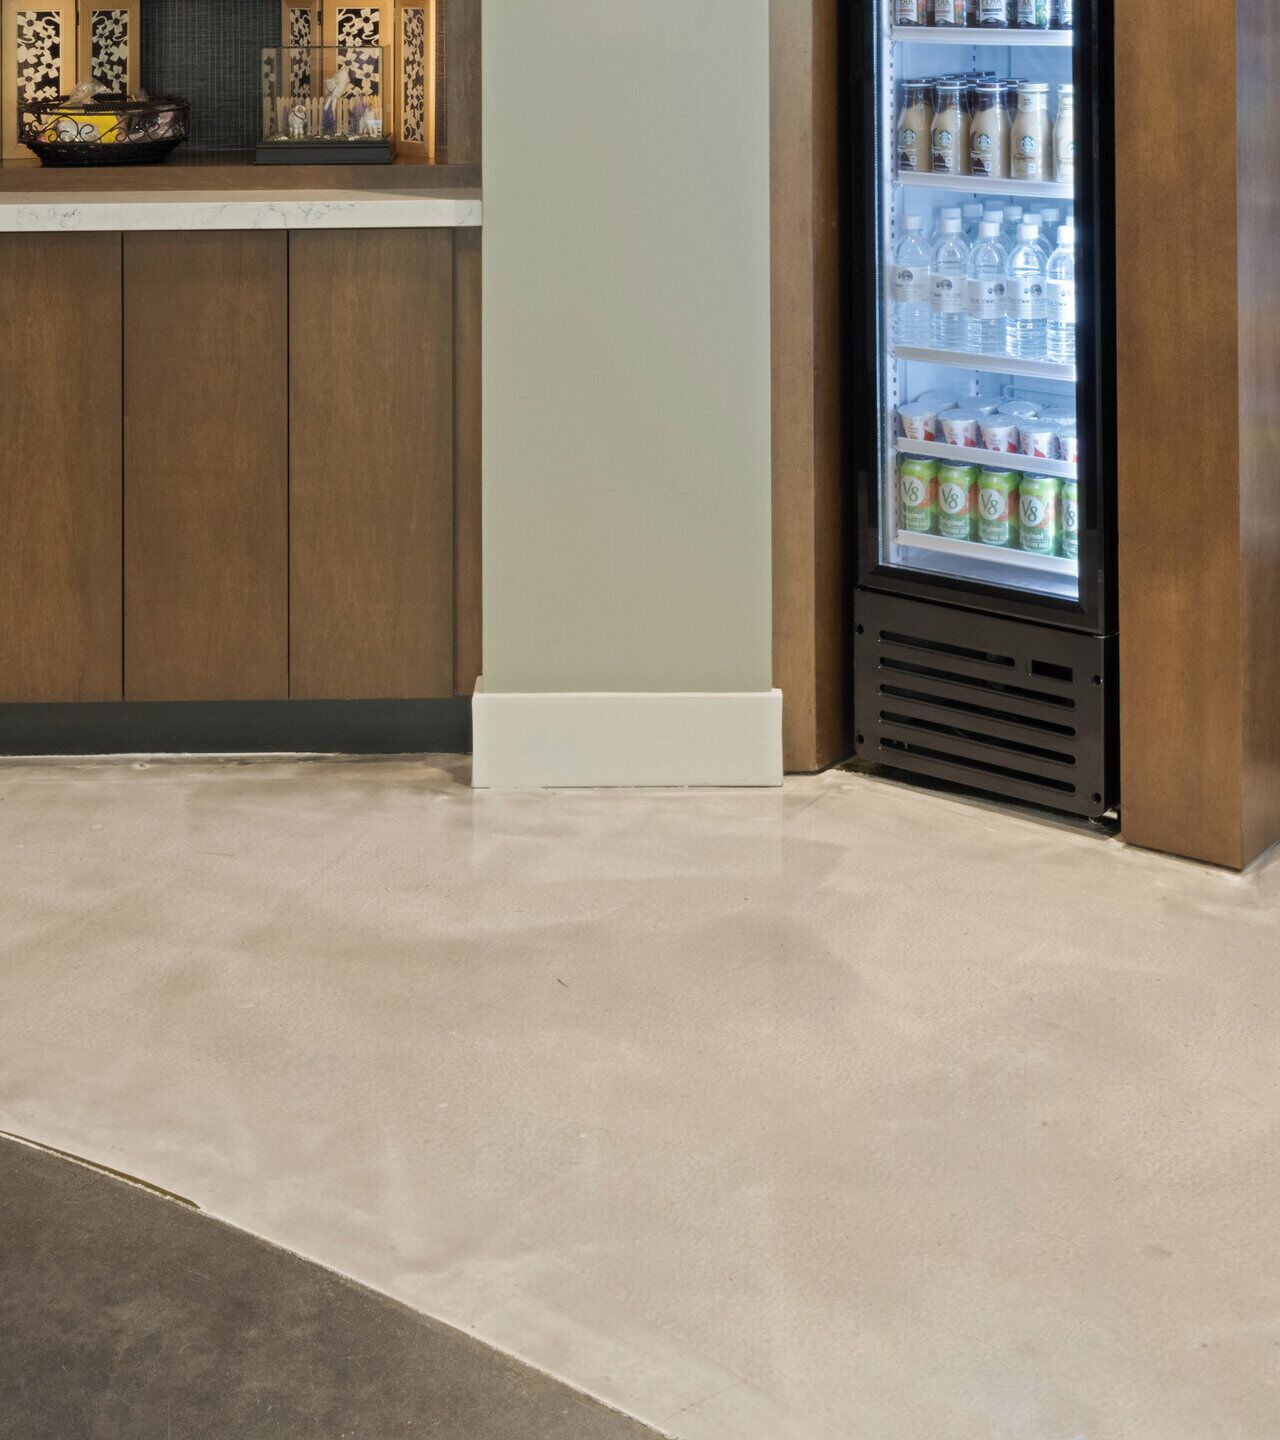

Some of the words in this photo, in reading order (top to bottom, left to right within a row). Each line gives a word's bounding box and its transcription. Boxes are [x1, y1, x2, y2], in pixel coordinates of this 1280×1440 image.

[902, 480, 919, 502] V8
[941, 487, 959, 510] V8
[980, 493, 998, 515] V8
[1021, 499, 1038, 522] V8
